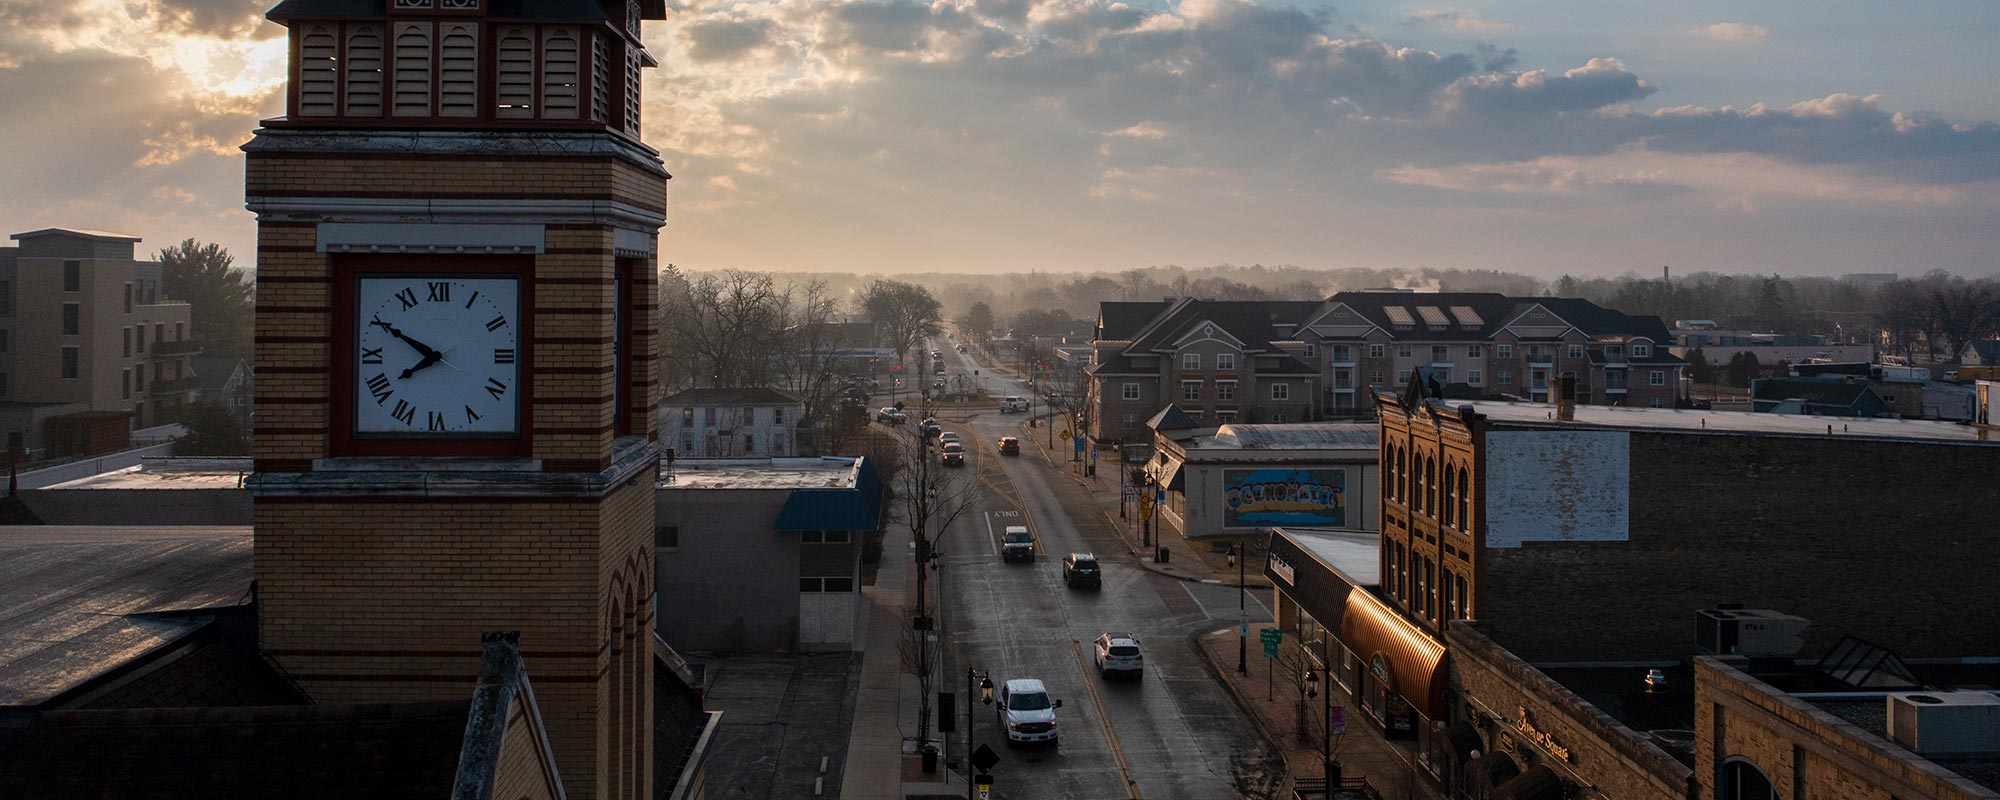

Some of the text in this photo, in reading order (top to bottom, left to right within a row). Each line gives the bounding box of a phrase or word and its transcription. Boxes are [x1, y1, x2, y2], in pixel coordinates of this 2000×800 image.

[394, 287, 419, 312] XI
[427, 282, 450, 302] XII
[465, 291, 479, 309] I
[370, 314, 392, 333] X
[485, 315, 507, 333] II
[362, 347, 383, 365] IX
[494, 348, 514, 364] III
[366, 373, 394, 405] VIII
[484, 377, 507, 401] IV
[390, 399, 416, 426] VII
[428, 411, 446, 432] VI
[465, 404, 481, 424] V
[1545, 732, 1569, 763] Square
